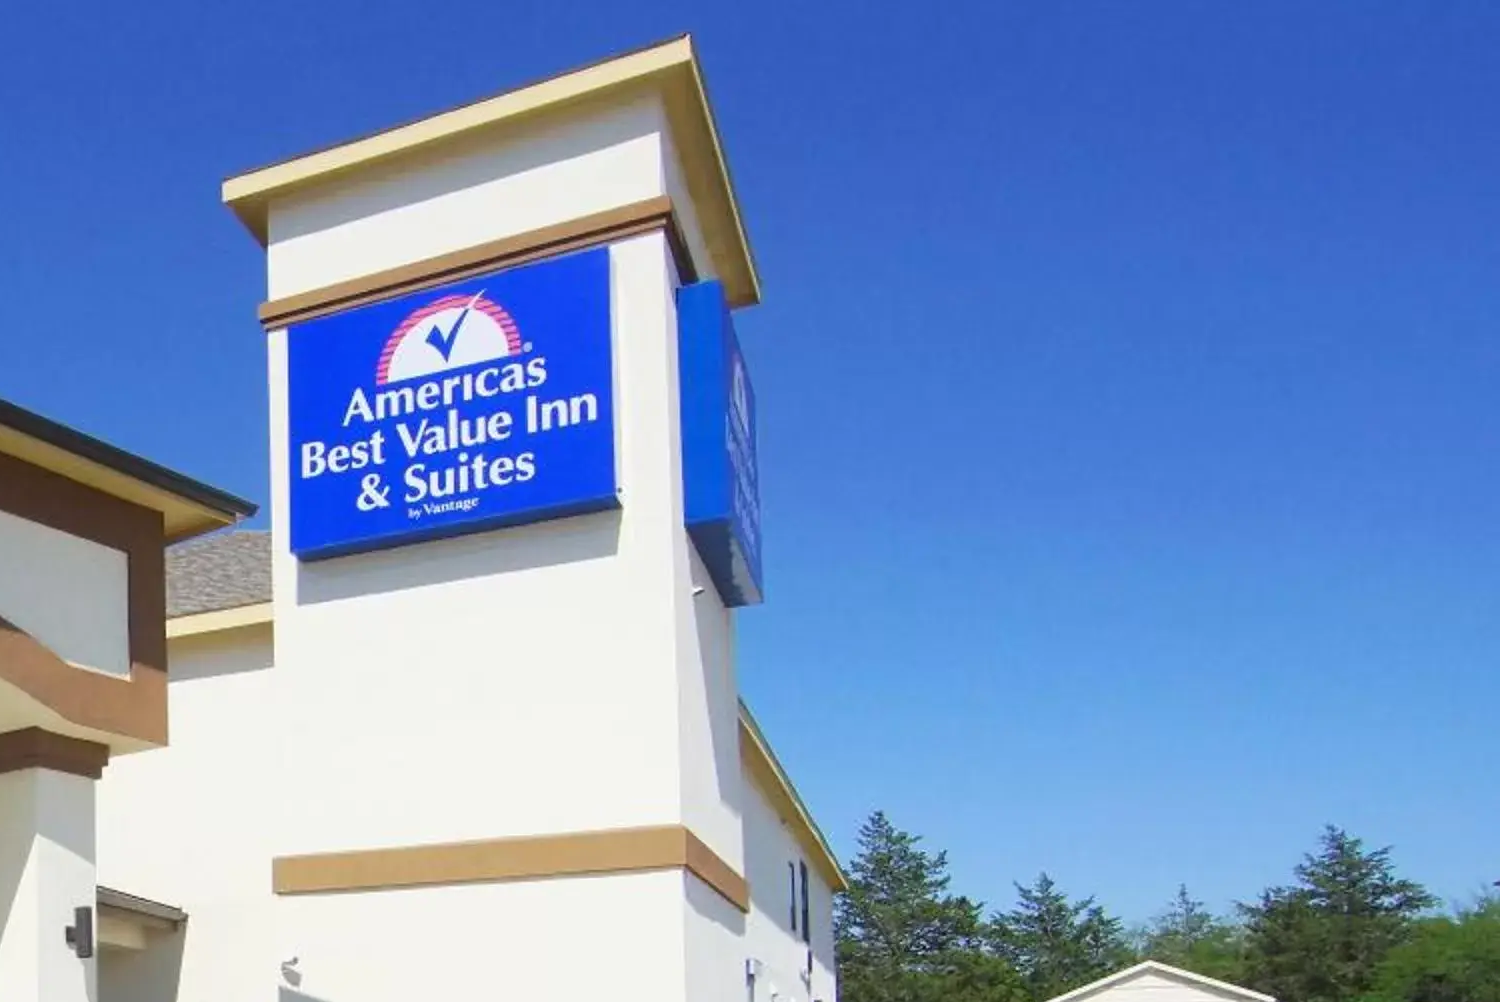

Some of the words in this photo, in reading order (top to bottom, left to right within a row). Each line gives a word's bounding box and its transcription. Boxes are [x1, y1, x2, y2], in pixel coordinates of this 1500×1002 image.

[342, 356, 547, 427] Americas
[300, 429, 386, 479] Best
[395, 408, 513, 458] Value
[526, 393, 597, 433] Inn
[356, 473, 391, 512] &
[403, 450, 536, 503] Suites
[407, 507, 422, 520] by
[422, 497, 480, 515] Vantage
